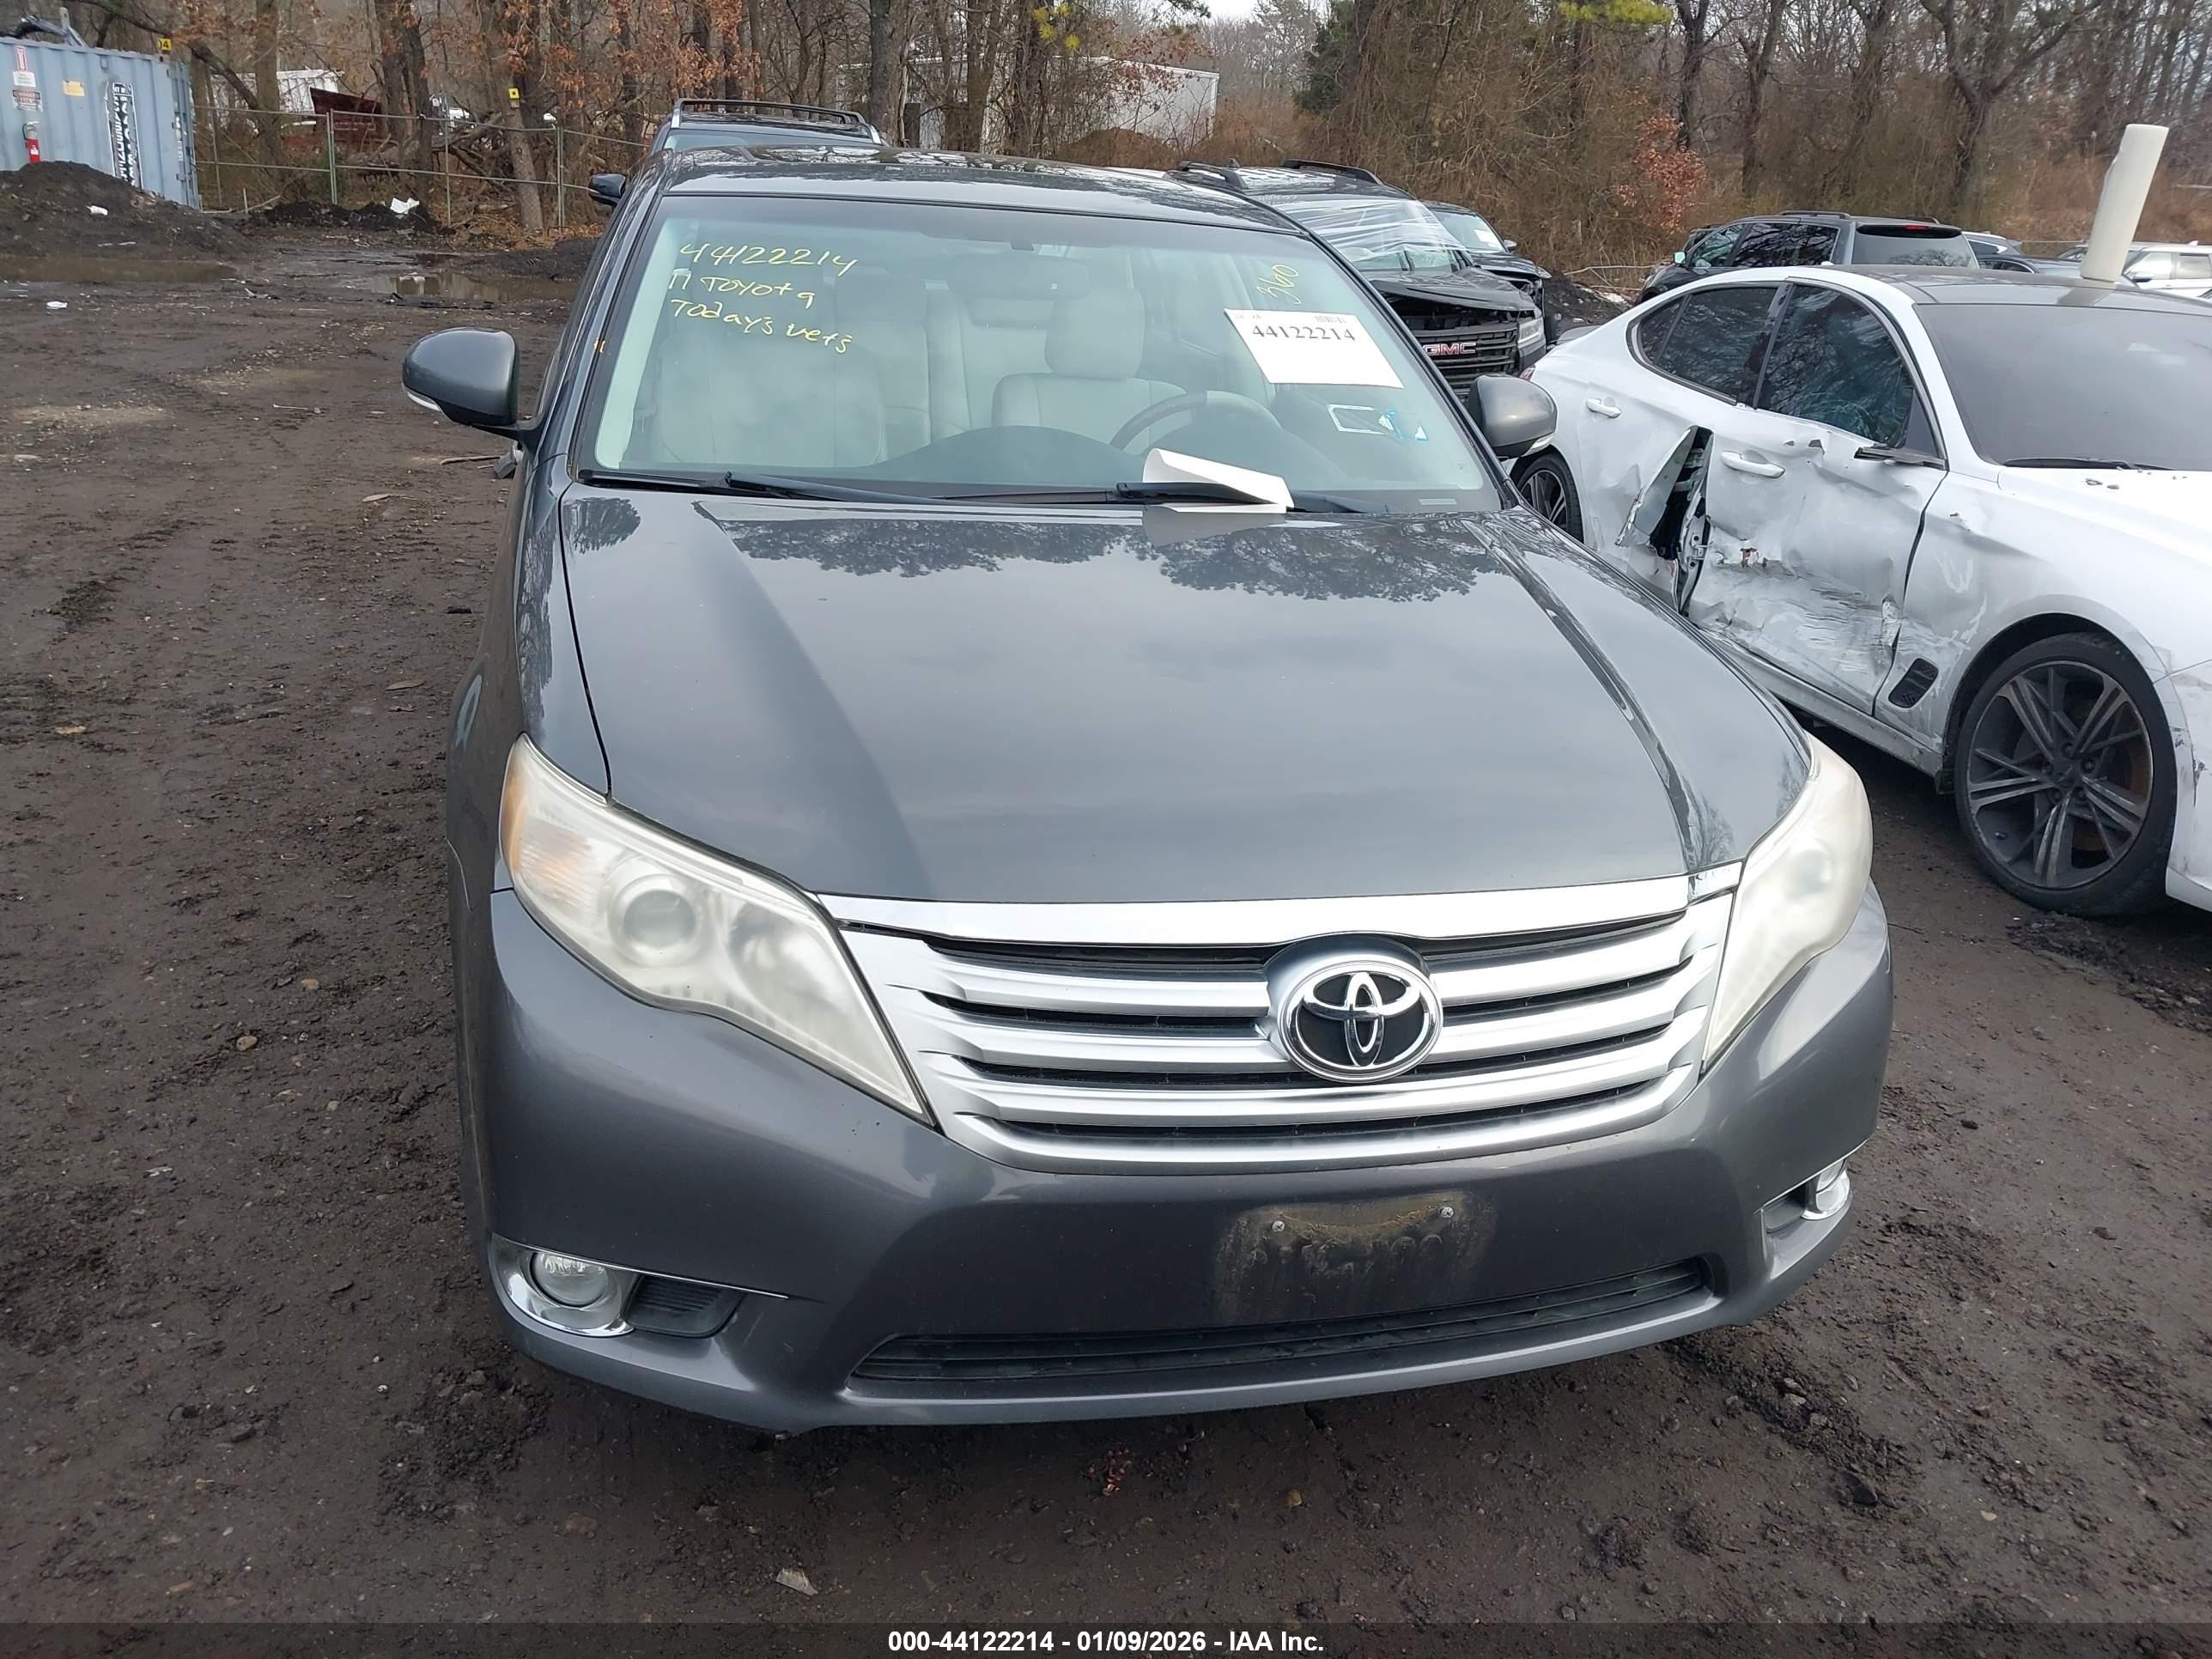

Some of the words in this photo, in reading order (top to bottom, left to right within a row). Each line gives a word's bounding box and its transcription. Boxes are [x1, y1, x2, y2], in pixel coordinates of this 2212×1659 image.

[680, 243, 858, 276] 44122214
[1252, 325, 1356, 341] 44122214
[1424, 342, 1477, 356] GMC
